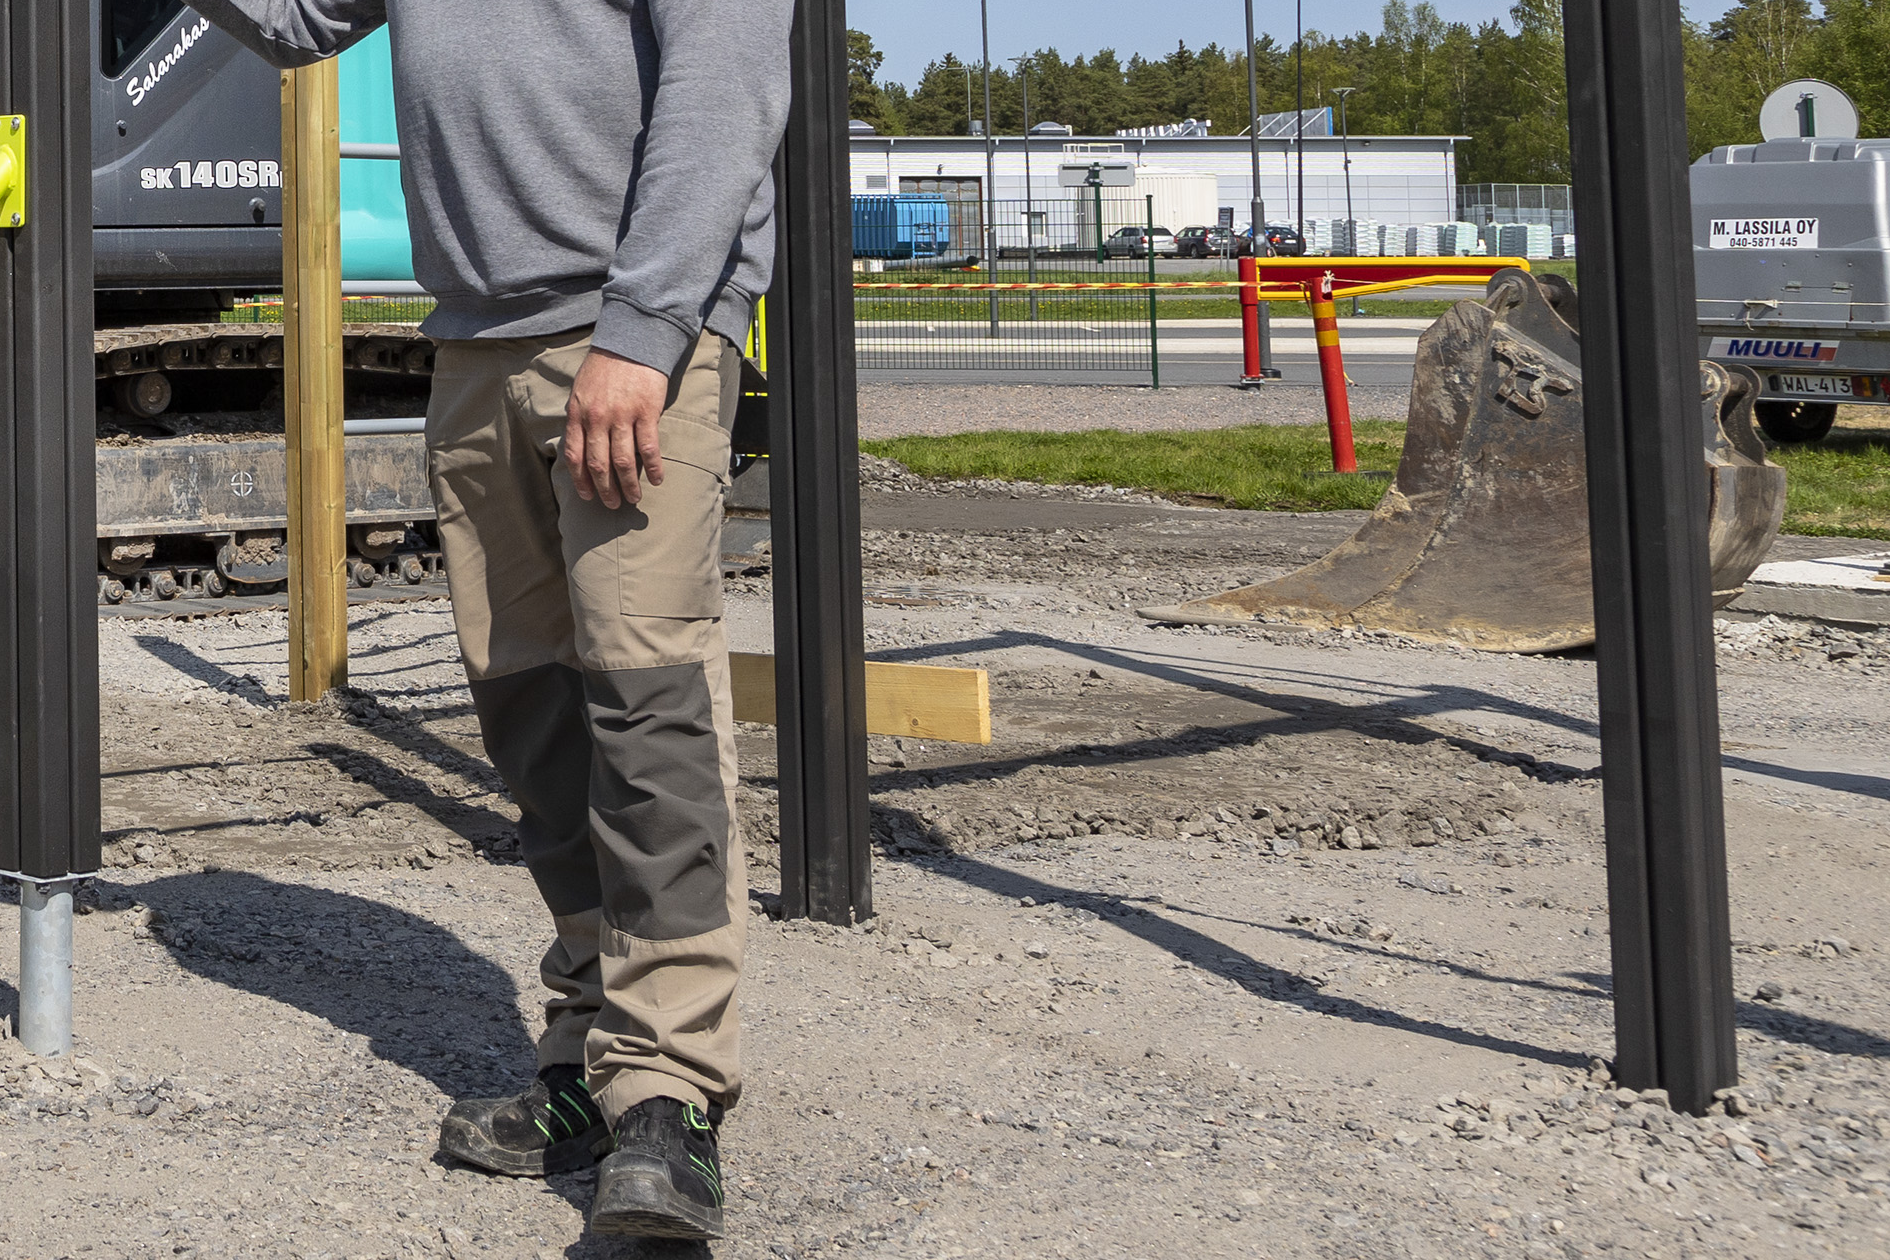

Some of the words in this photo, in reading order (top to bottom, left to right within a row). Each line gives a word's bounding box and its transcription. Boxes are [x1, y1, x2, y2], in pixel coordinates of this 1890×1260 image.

[126, 16, 210, 107] Salarakas
[140, 160, 282, 189] SK140SR
[1713, 221, 1730, 235] M.
[1735, 220, 1792, 235] LASSILA
[1796, 219, 1816, 234] OY
[1729, 237, 1776, 247] 040-5871
[1779, 237, 1798, 247] 445
[1727, 339, 1822, 358] MUULI
